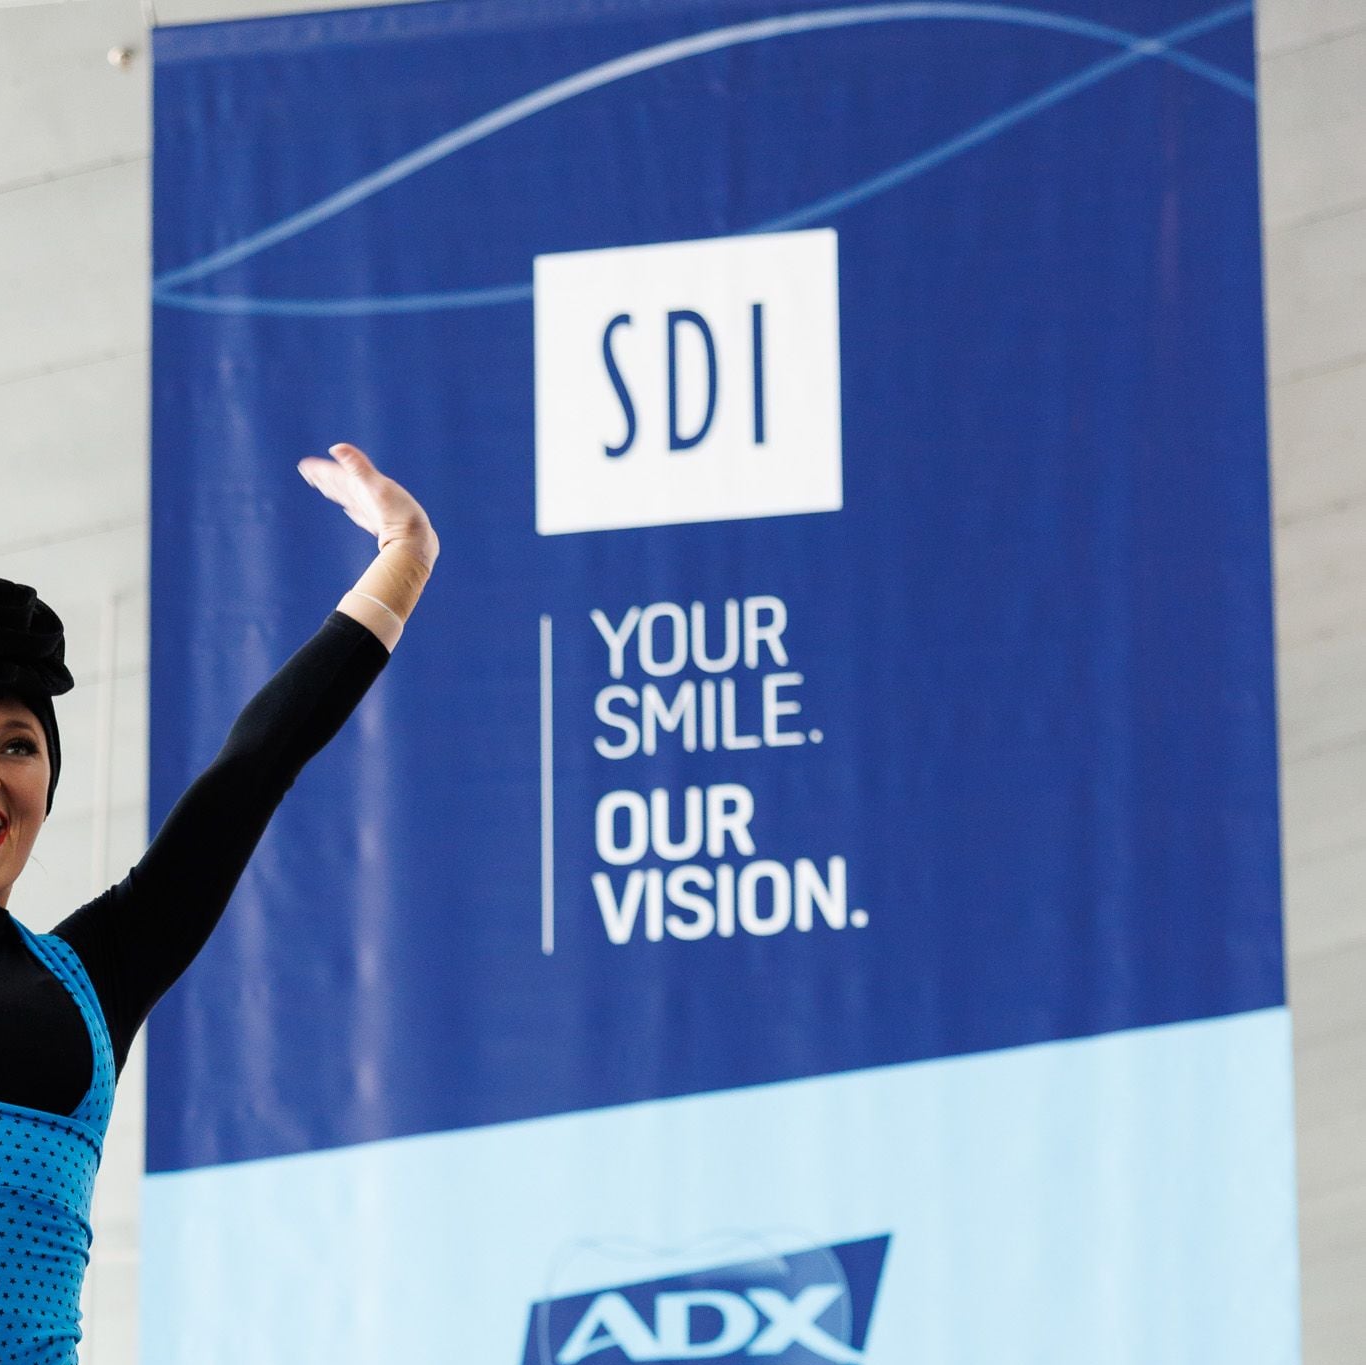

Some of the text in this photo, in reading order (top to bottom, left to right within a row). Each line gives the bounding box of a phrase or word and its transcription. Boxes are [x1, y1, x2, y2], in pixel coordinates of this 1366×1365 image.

[600, 303, 767, 458] SDI
[589, 595, 789, 680] YOUR
[593, 672, 824, 759] SMILE.
[595, 783, 757, 865] OUR
[590, 855, 870, 945] VISION.
[557, 1283, 864, 1365] ADX
